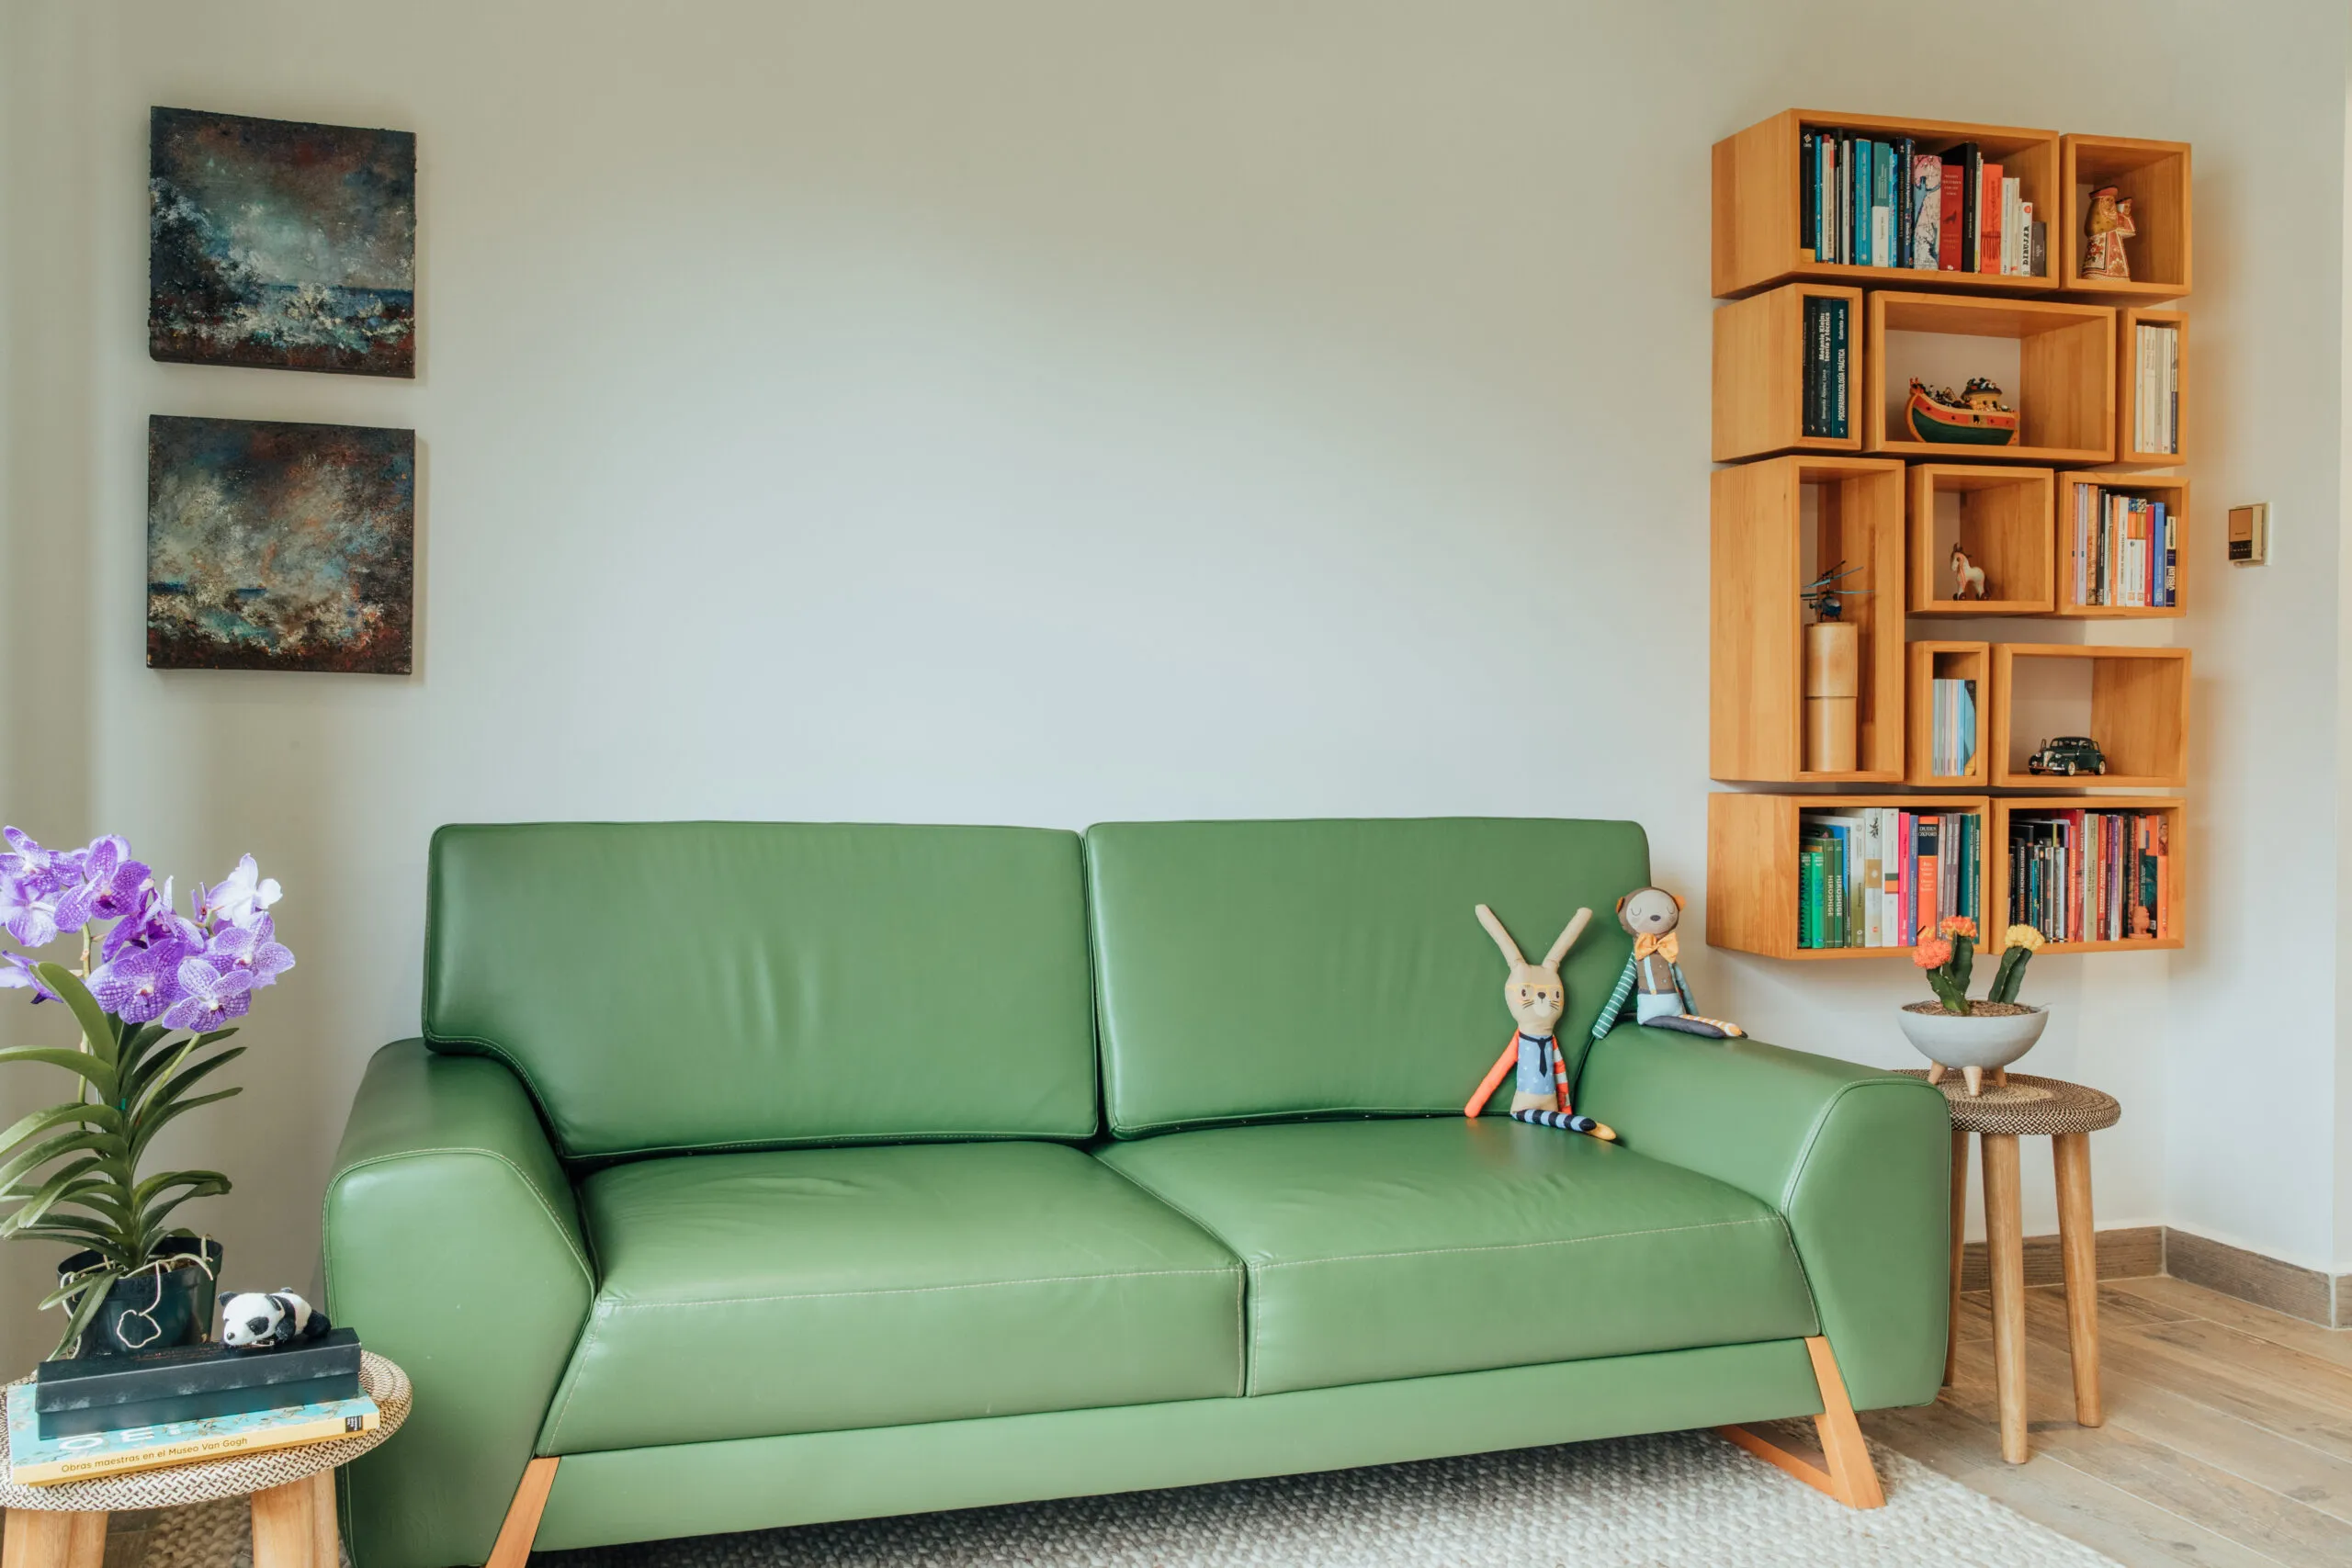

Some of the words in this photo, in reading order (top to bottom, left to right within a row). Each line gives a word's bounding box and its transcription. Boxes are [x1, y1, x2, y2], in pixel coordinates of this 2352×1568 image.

[2166, 566, 2175, 591] visual
[61, 1461, 91, 1473] Obras
[95, 1455, 140, 1467] maestras
[143, 1451, 154, 1460] en
[169, 1446, 199, 1455] Museo
[202, 1442, 220, 1450] Van
[223, 1437, 248, 1447] Gogh
